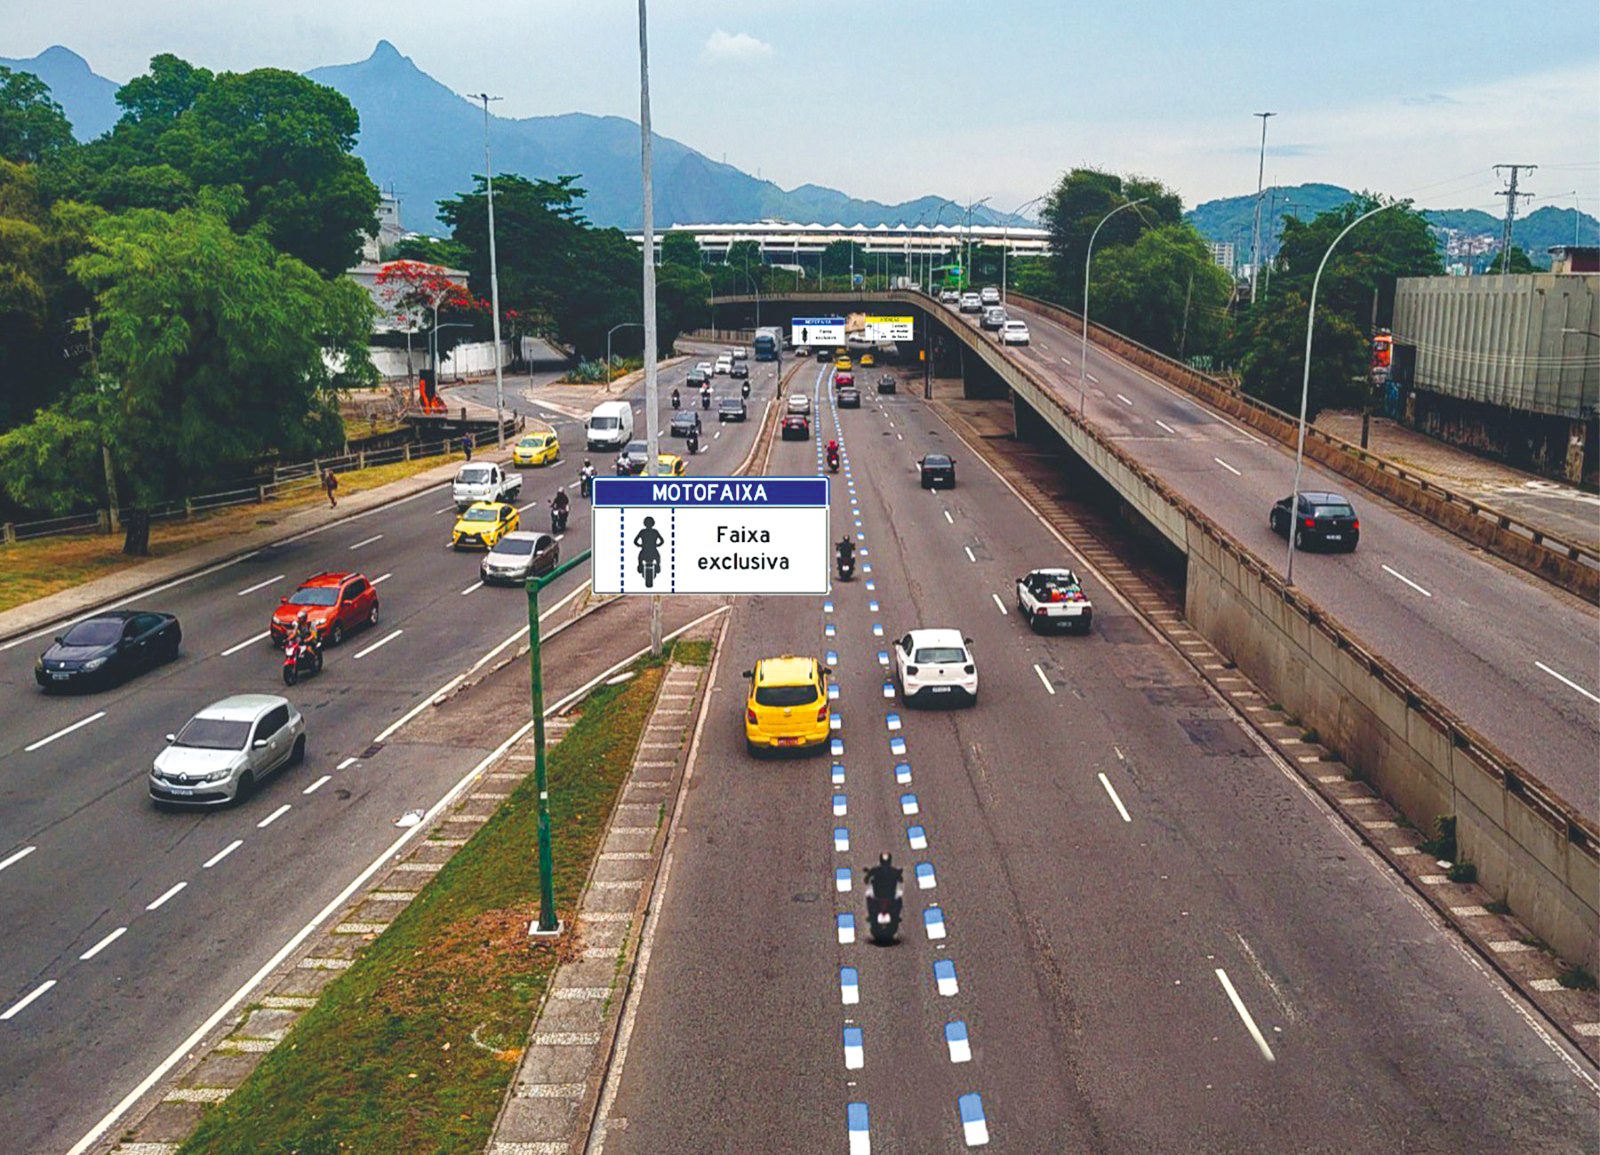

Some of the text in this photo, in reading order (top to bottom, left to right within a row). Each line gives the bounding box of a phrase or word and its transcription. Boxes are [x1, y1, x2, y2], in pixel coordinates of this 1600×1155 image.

[652, 484, 768, 502] MOTOFAIXA
[717, 525, 770, 543] Faixa
[698, 552, 789, 570] exclusiva
